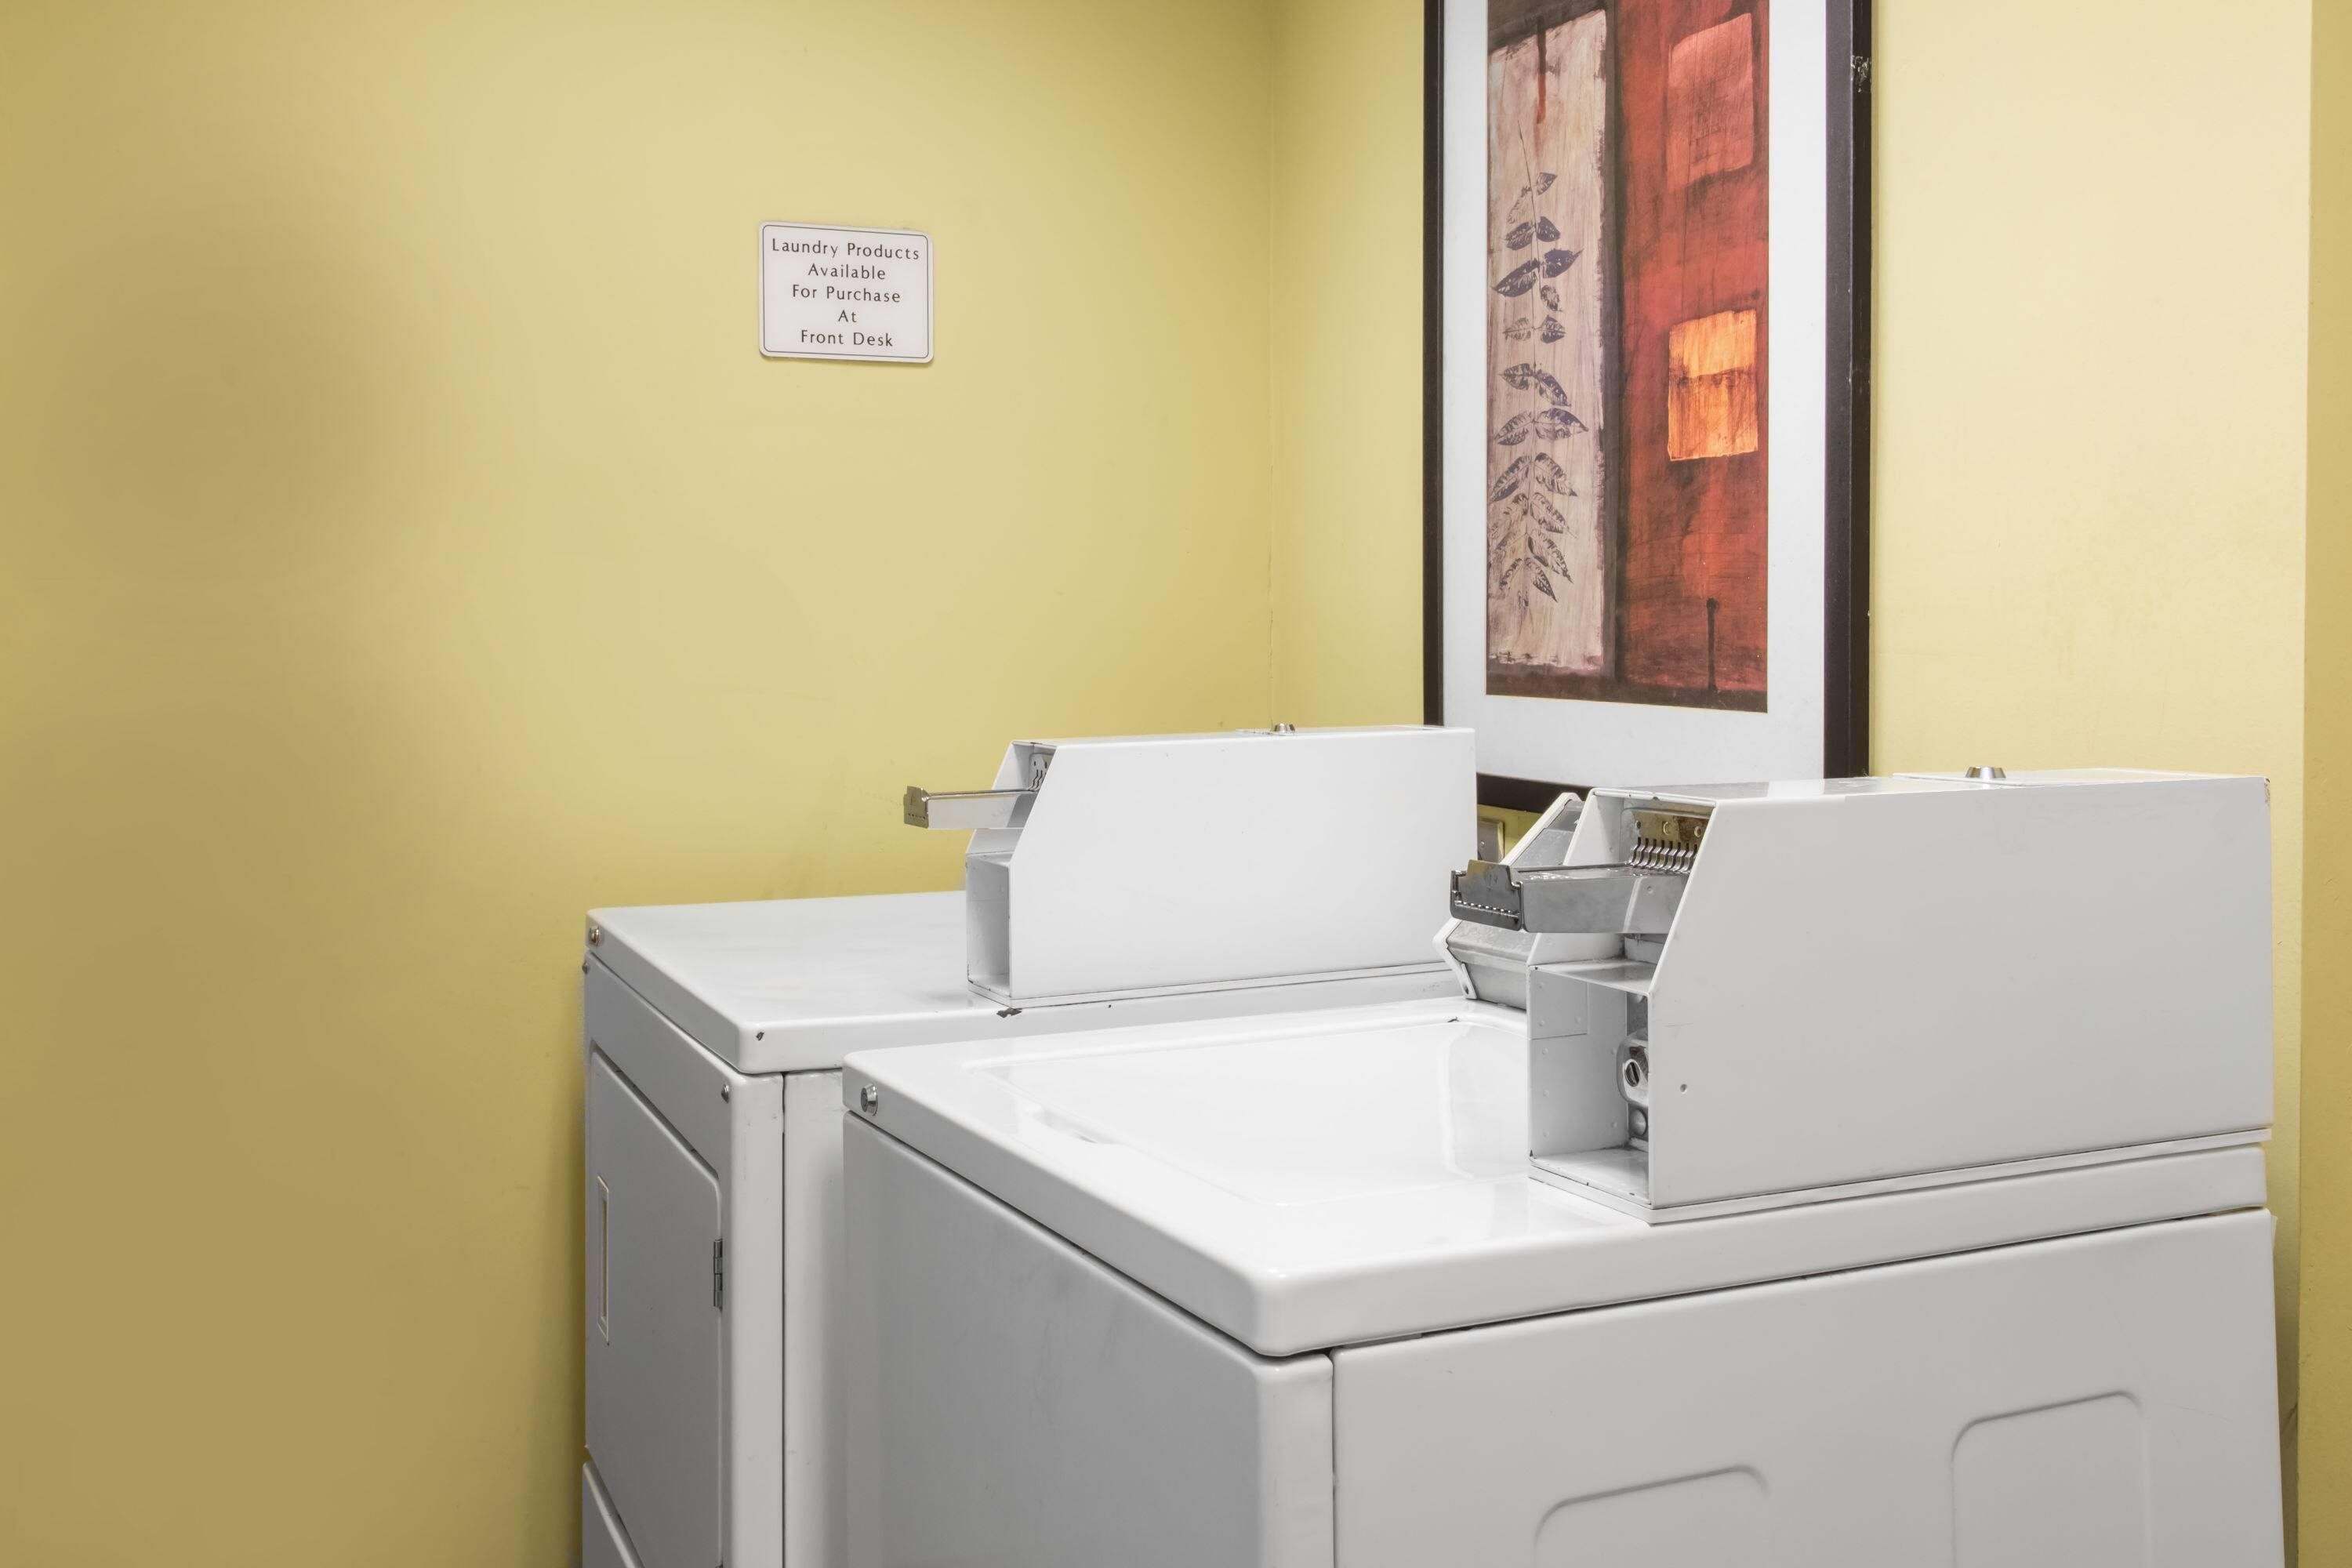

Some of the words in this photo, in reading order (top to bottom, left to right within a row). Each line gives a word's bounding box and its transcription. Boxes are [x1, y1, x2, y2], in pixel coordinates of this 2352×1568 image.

[772, 238, 838, 258] Laundry
[847, 242, 919, 260] Products
[808, 263, 886, 280] Available
[793, 284, 818, 299] For
[826, 285, 901, 303] Purchase
[837, 309, 857, 323] At
[800, 329, 844, 345] Front
[853, 332, 893, 347] Desk
